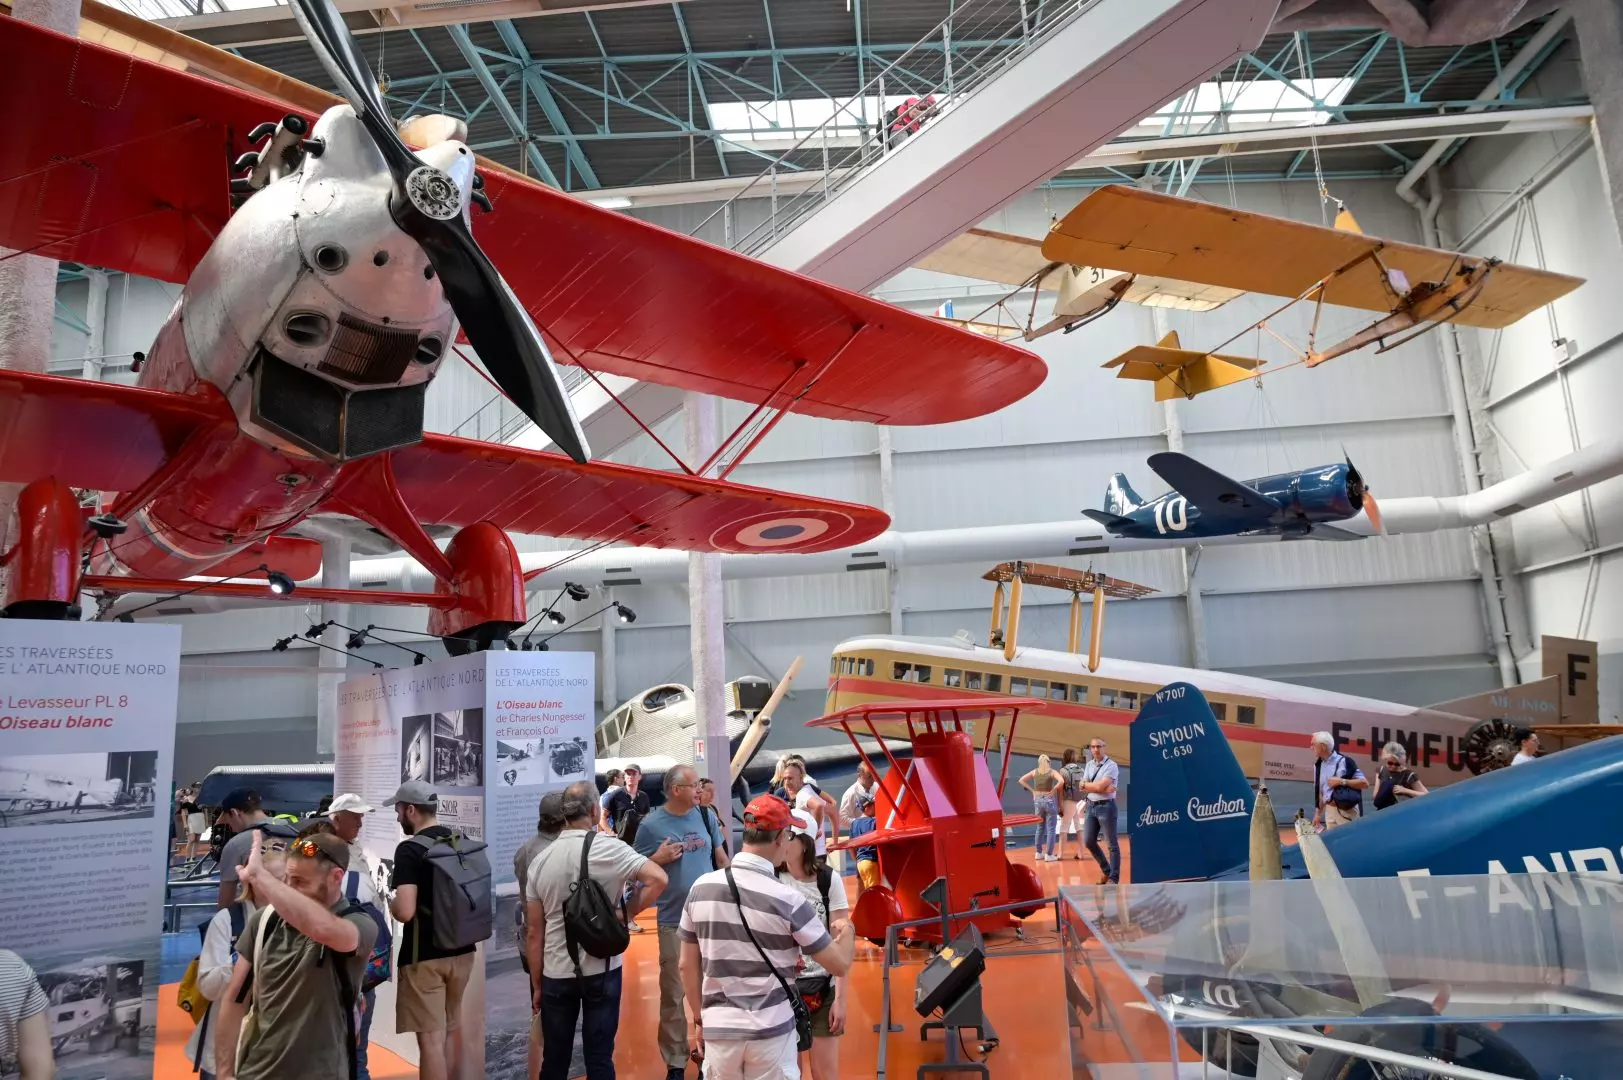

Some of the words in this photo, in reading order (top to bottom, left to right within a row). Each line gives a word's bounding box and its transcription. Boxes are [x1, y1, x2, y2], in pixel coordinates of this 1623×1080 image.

[1155, 497, 1188, 534] 10
[0, 646, 15, 658] ES
[21, 645, 114, 660] TRAVERSÉES
[125, 663, 167, 676] NORD
[459, 668, 485, 685] NORD
[495, 668, 510, 677] LES
[513, 667, 560, 677] TRAVERSÉES
[1567, 653, 1590, 696] F
[495, 679, 505, 687] DE
[567, 678, 588, 687] NORD
[1165, 686, 1186, 702] 7017
[8, 695, 92, 709] Levasseur
[95, 695, 114, 708] PL
[119, 695, 129, 708] 8
[496, 700, 537, 710] L'Oiseau
[538, 700, 563, 709] blanc
[0, 716, 62, 730] Oiseau
[66, 715, 114, 728] blanc
[496, 714, 508, 723] de
[509, 713, 540, 723] Charles
[542, 712, 586, 723] Nungesser
[495, 728, 505, 737] et
[506, 726, 541, 738] François
[543, 725, 559, 735] Coli
[1150, 721, 1206, 747] SIMOUN
[437, 799, 458, 814] LSIOR
[1136, 805, 1180, 827] Avions
[1187, 793, 1250, 822] Caudron
[1397, 846, 1623, 920] F-ANR
